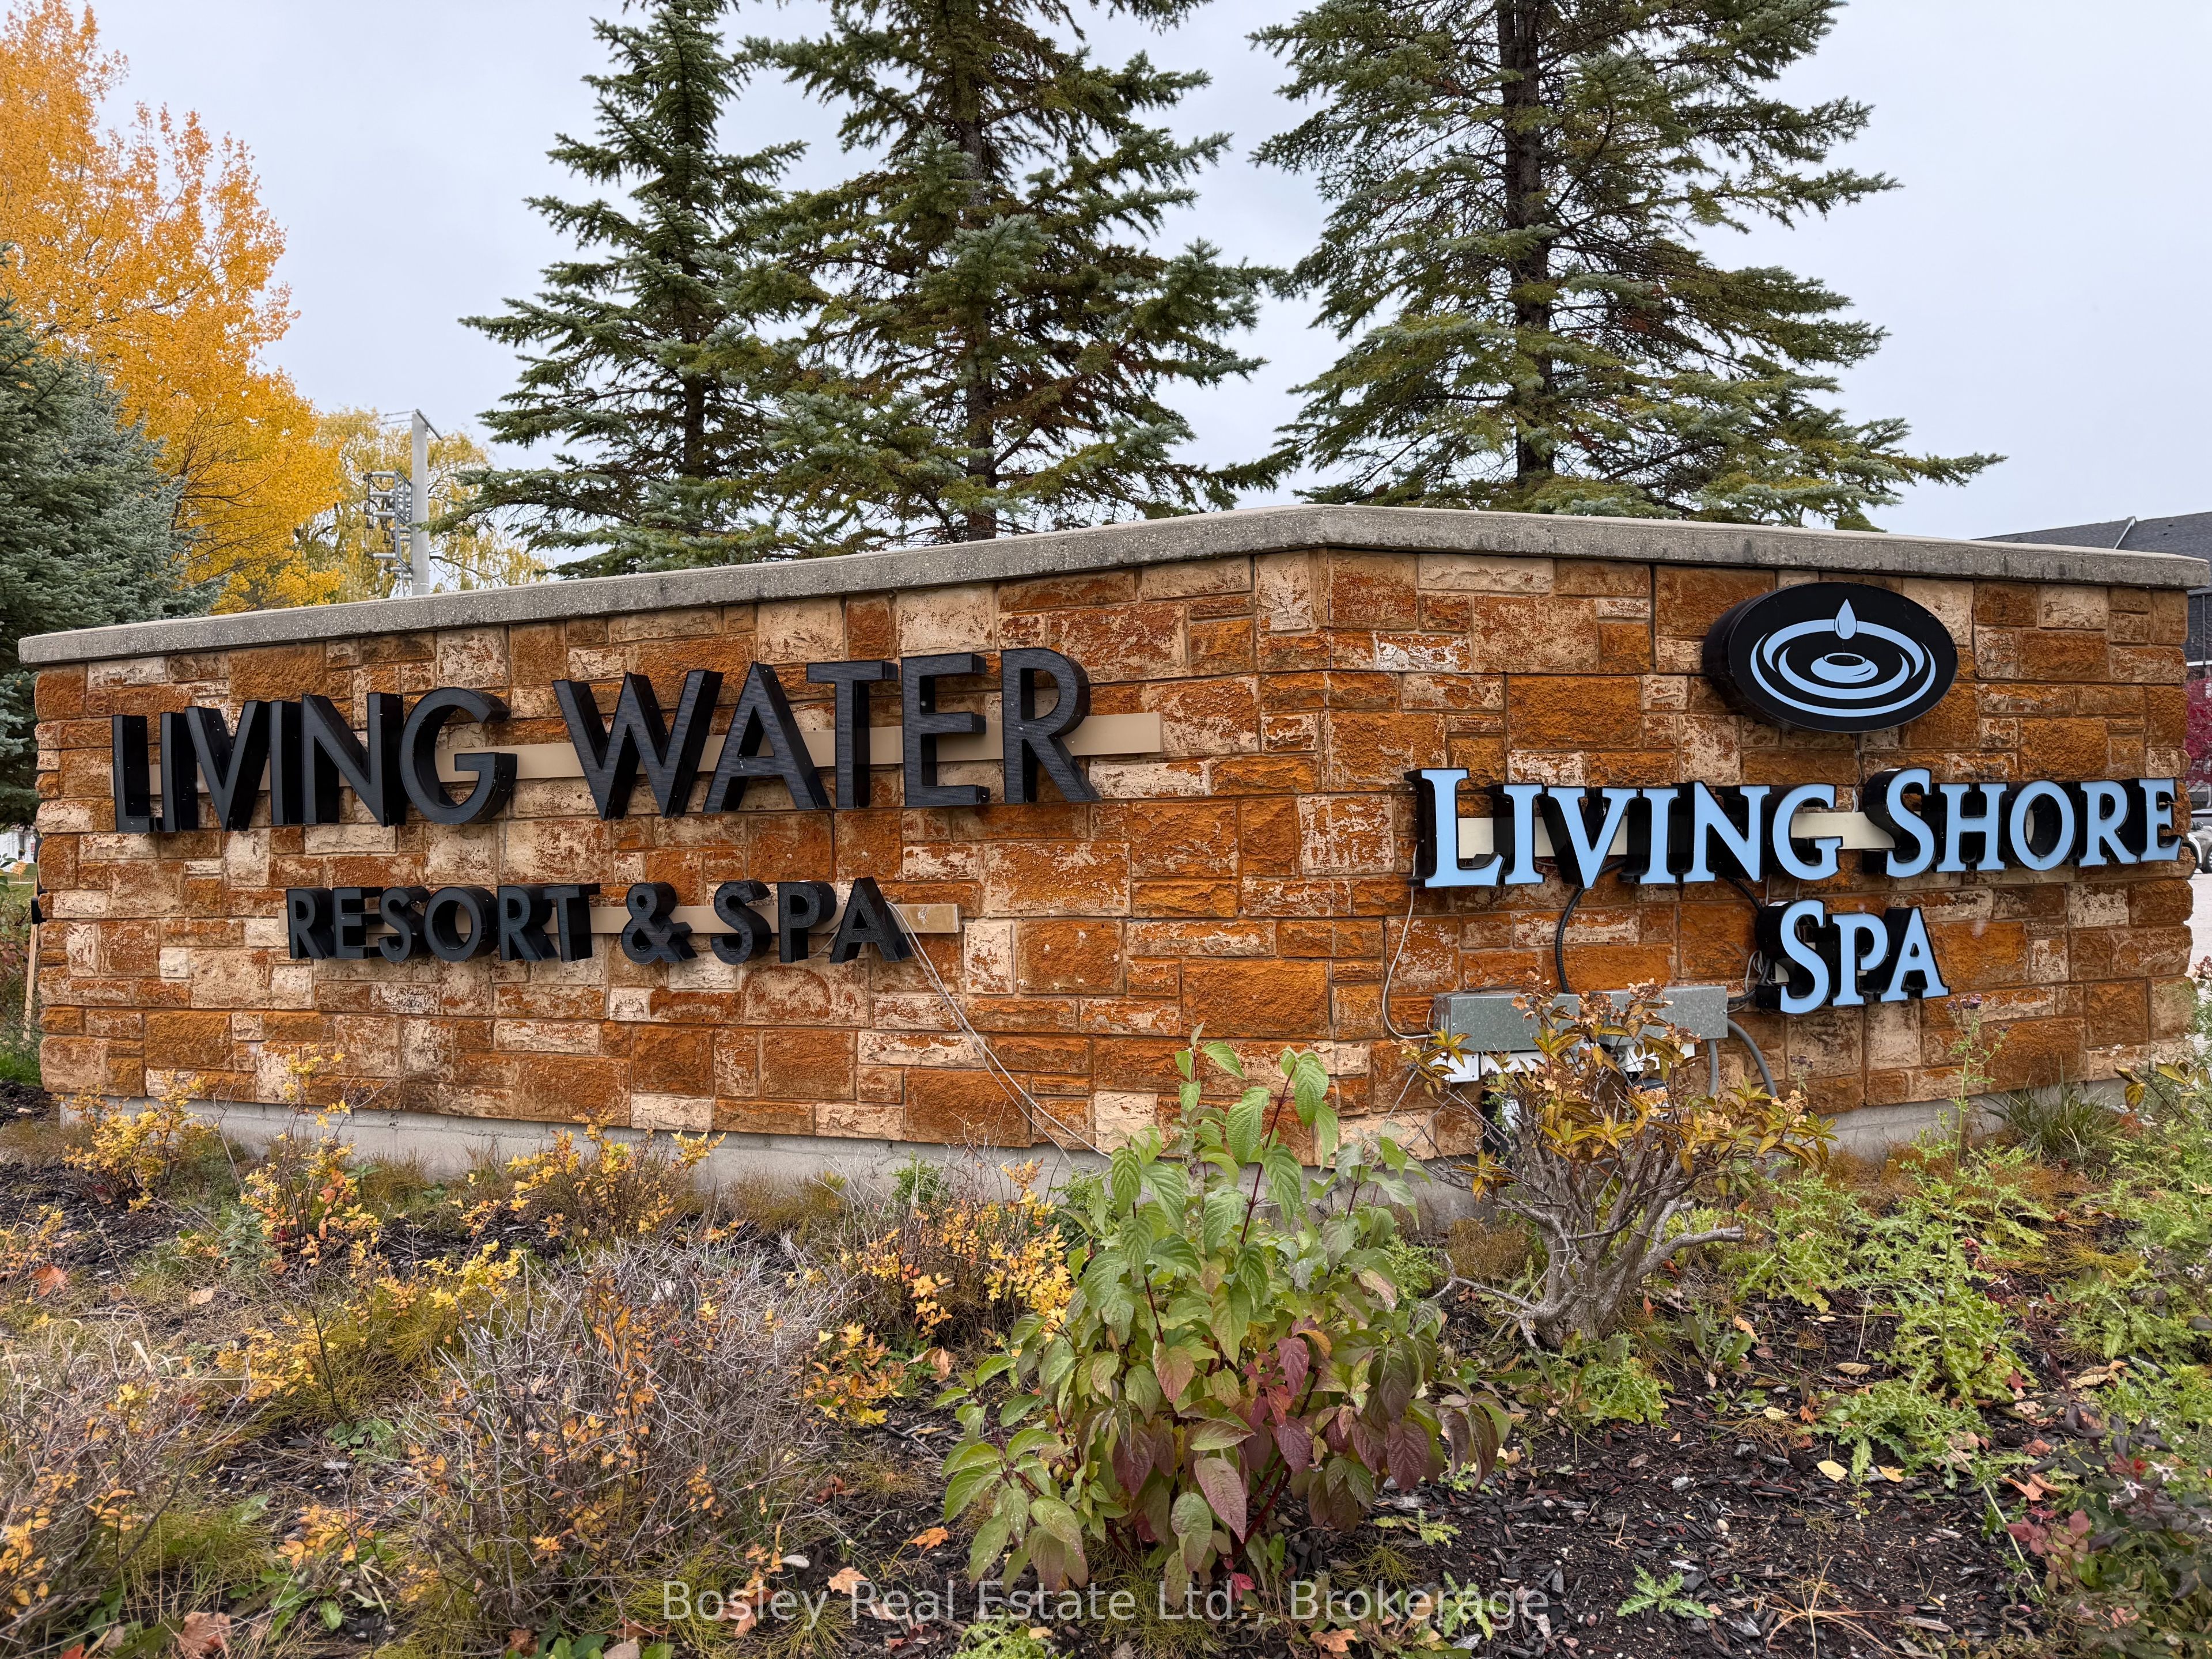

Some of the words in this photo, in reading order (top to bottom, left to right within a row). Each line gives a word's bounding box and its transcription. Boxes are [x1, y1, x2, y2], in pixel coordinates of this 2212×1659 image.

[112, 687, 517, 833] LIVING
[552, 647, 1100, 821] WATER
[1404, 768, 1843, 889] LIVING
[1862, 767, 2184, 878] SHORE
[286, 884, 600, 963] RESORT
[621, 881, 697, 965] &
[710, 877, 912, 965] SPA
[1755, 899, 1950, 1015] SPA
